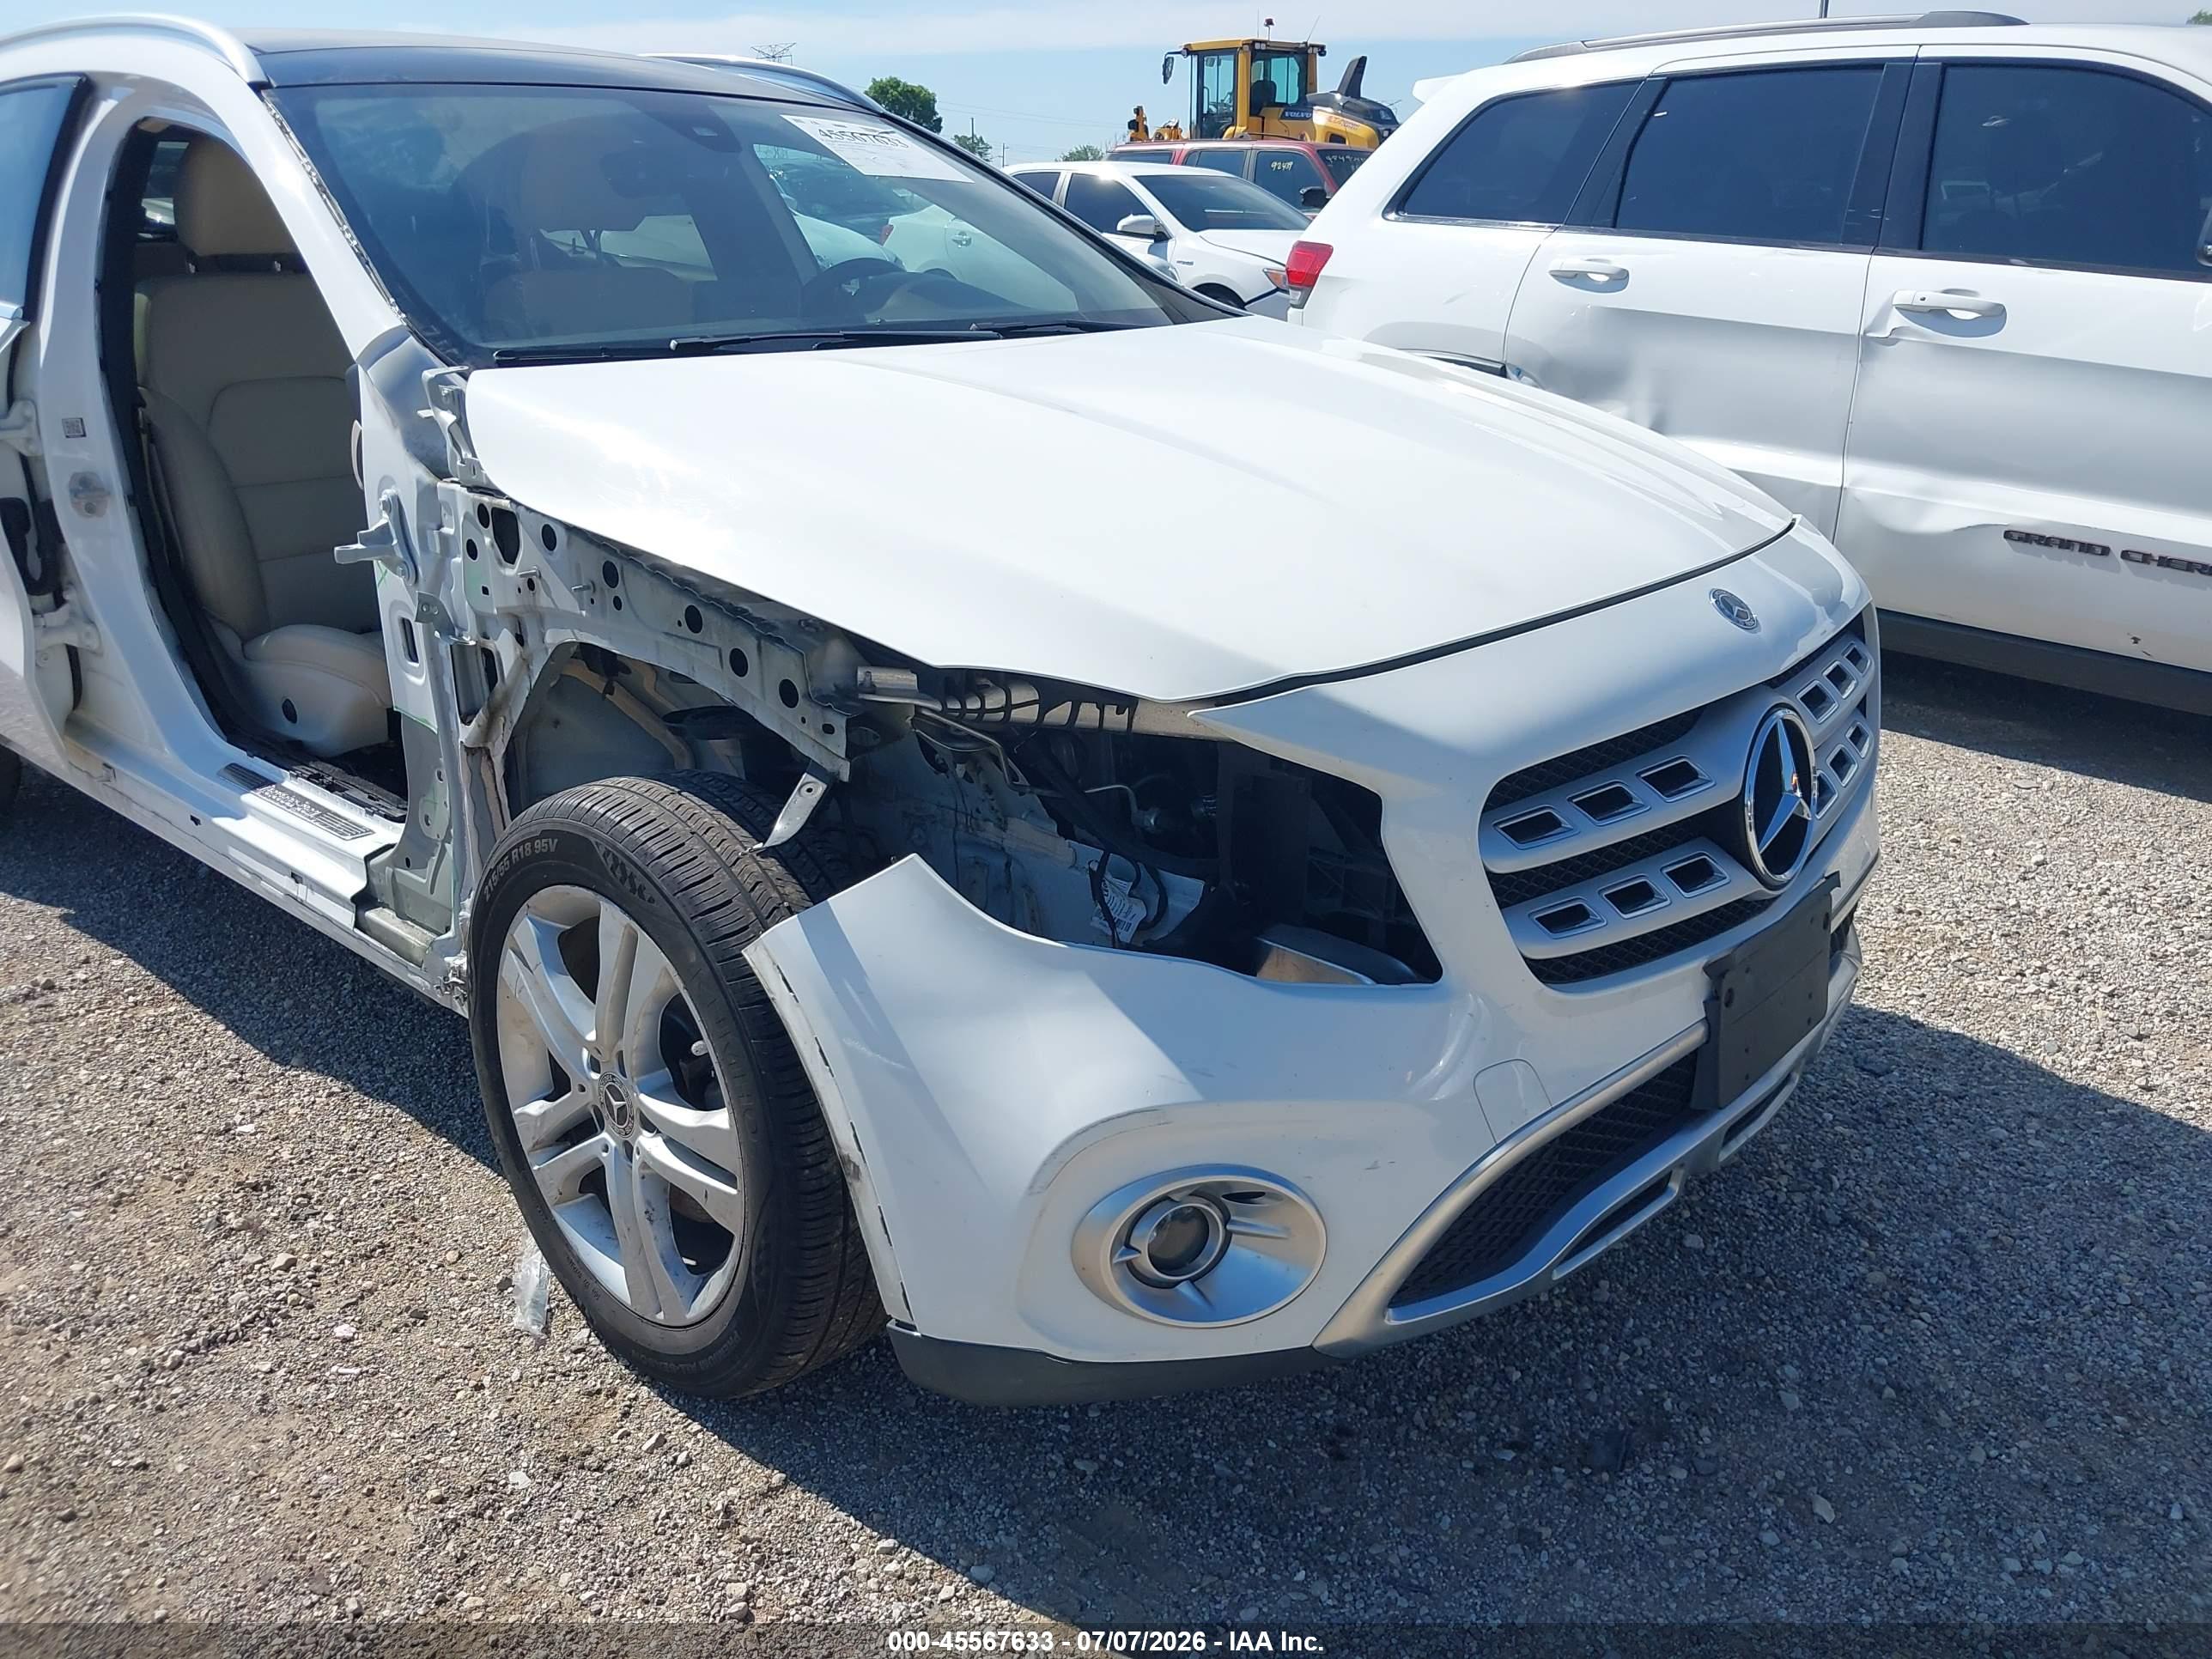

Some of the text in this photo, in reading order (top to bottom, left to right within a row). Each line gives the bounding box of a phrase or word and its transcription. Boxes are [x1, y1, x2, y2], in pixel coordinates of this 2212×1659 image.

[818, 128, 909, 149] 45567633
[2003, 530, 2212, 576] GRAND CHER
[511, 842, 532, 864] R18
[534, 838, 557, 854] 95V
